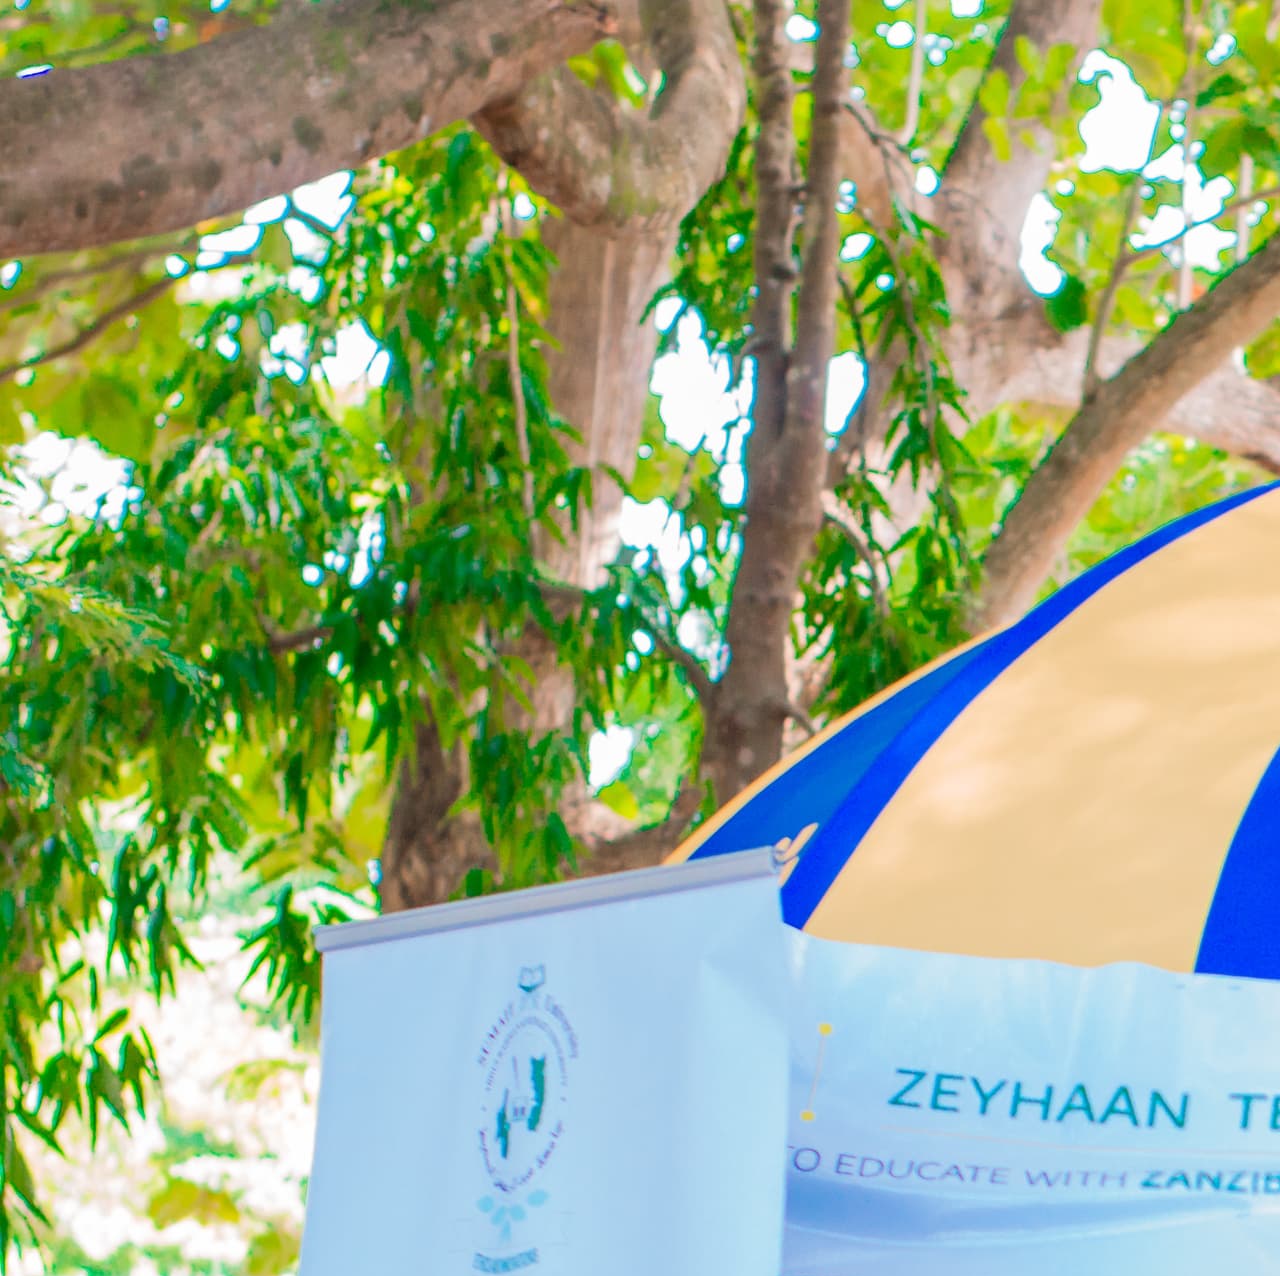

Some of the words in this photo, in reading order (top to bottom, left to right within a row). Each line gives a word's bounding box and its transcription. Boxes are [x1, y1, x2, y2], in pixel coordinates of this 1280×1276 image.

[886, 1067, 1191, 1130] ZEYHAAN
[834, 1152, 1010, 1187] EDUCATE
[1023, 1167, 1128, 1189] WITH
